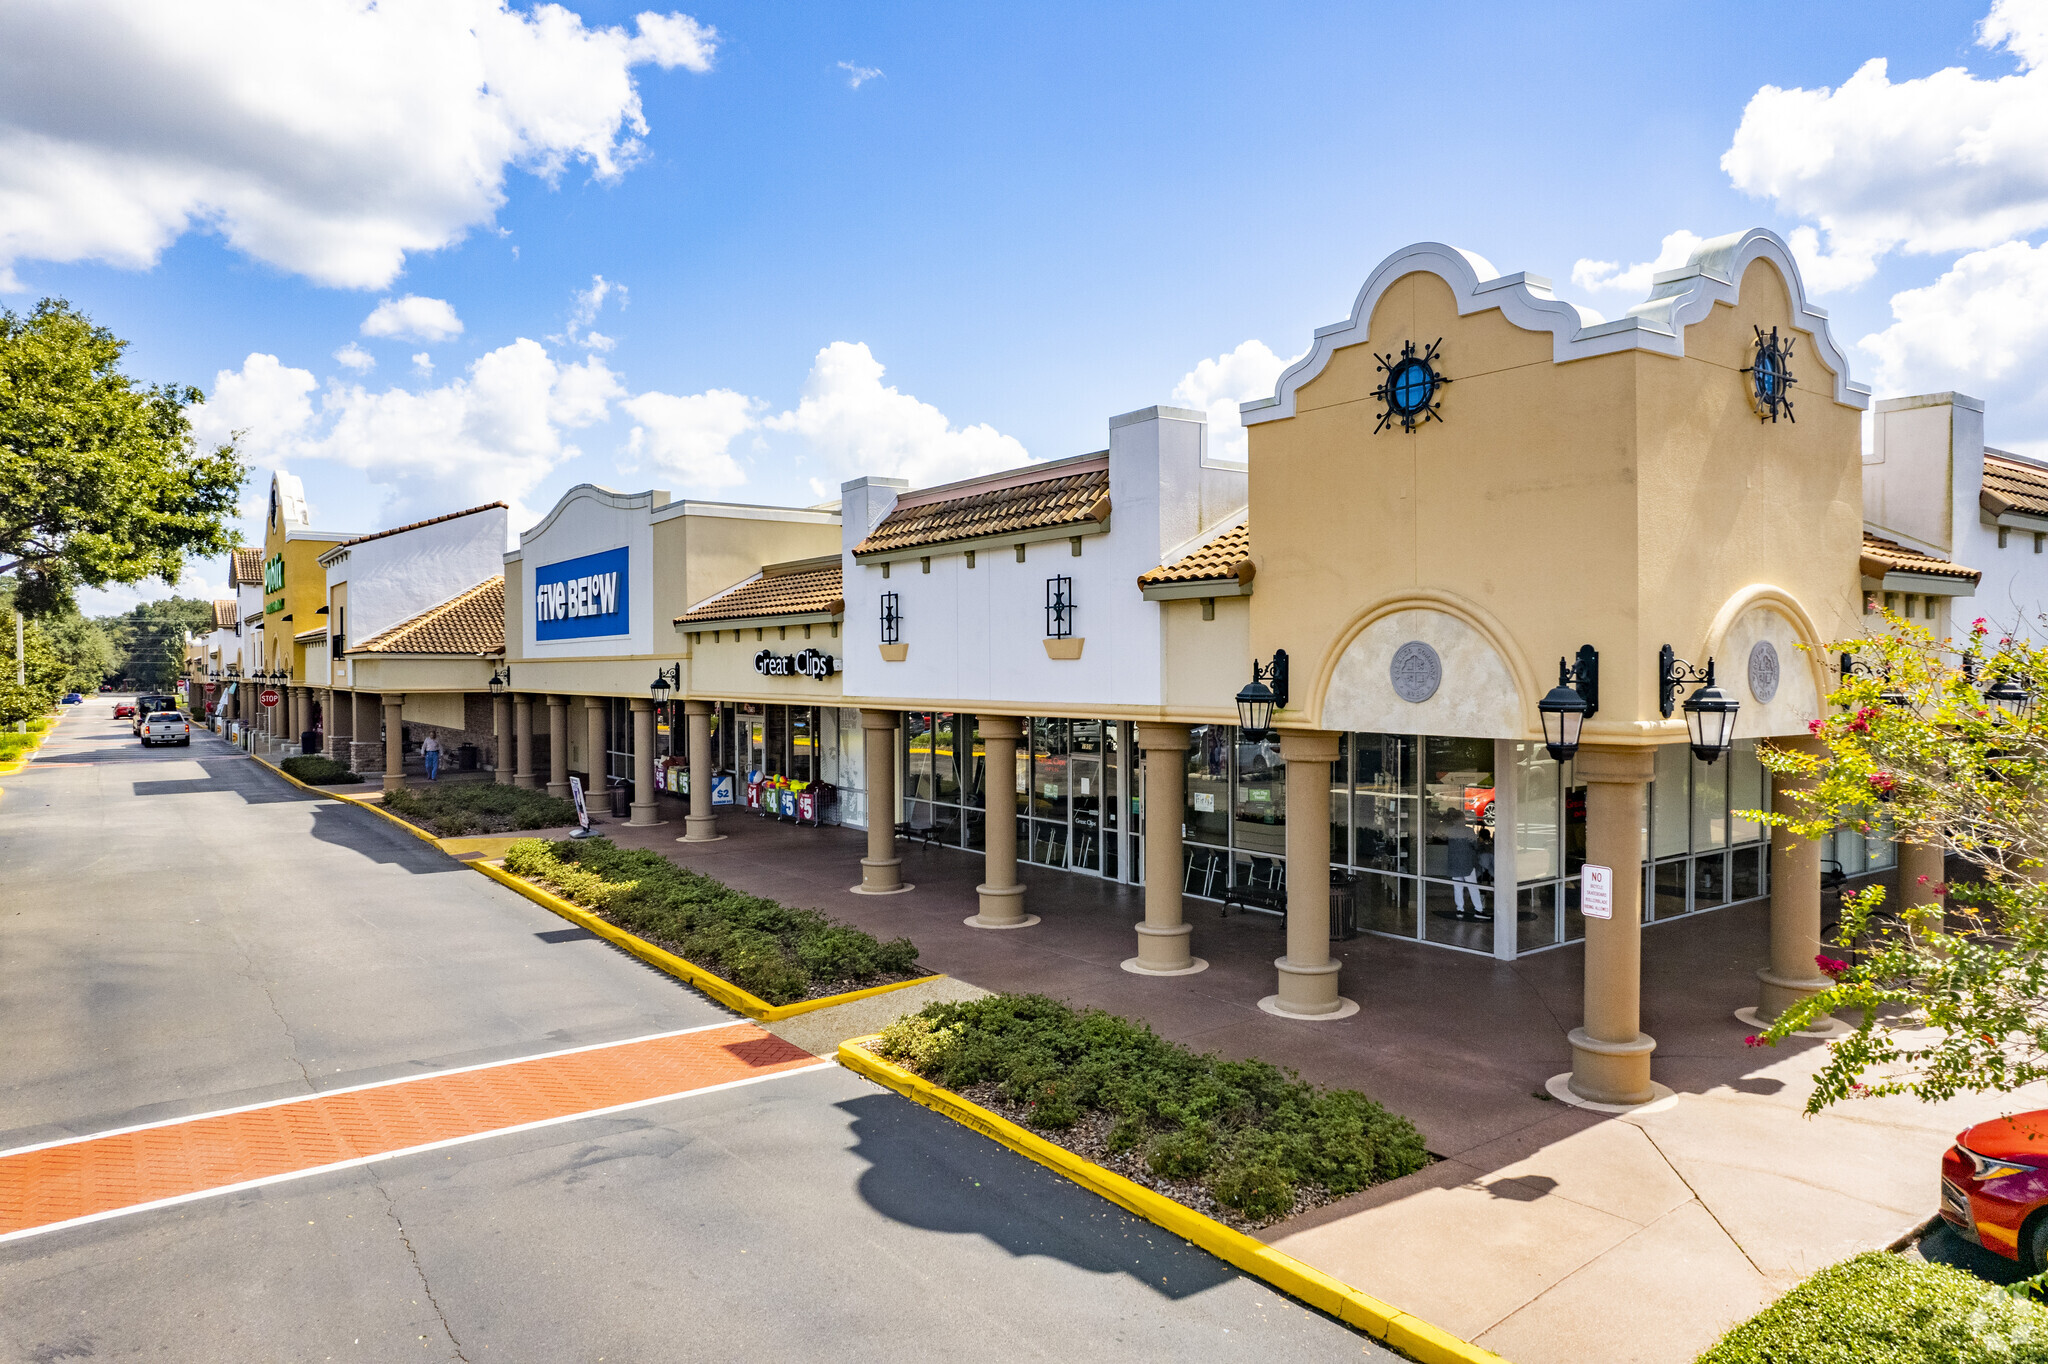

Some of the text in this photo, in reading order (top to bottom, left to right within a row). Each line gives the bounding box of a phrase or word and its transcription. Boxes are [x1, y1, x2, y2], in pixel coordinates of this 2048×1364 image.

[754, 650, 827, 679] Great Clips
[656, 771, 665, 789] $5
[680, 776, 689, 793] $5
[717, 789, 729, 798] $2
[748, 788, 759, 808] $1
[766, 792, 777, 812] $4
[782, 794, 794, 816] $5
[800, 797, 812, 819] $5
[1591, 872, 1603, 882] NO
